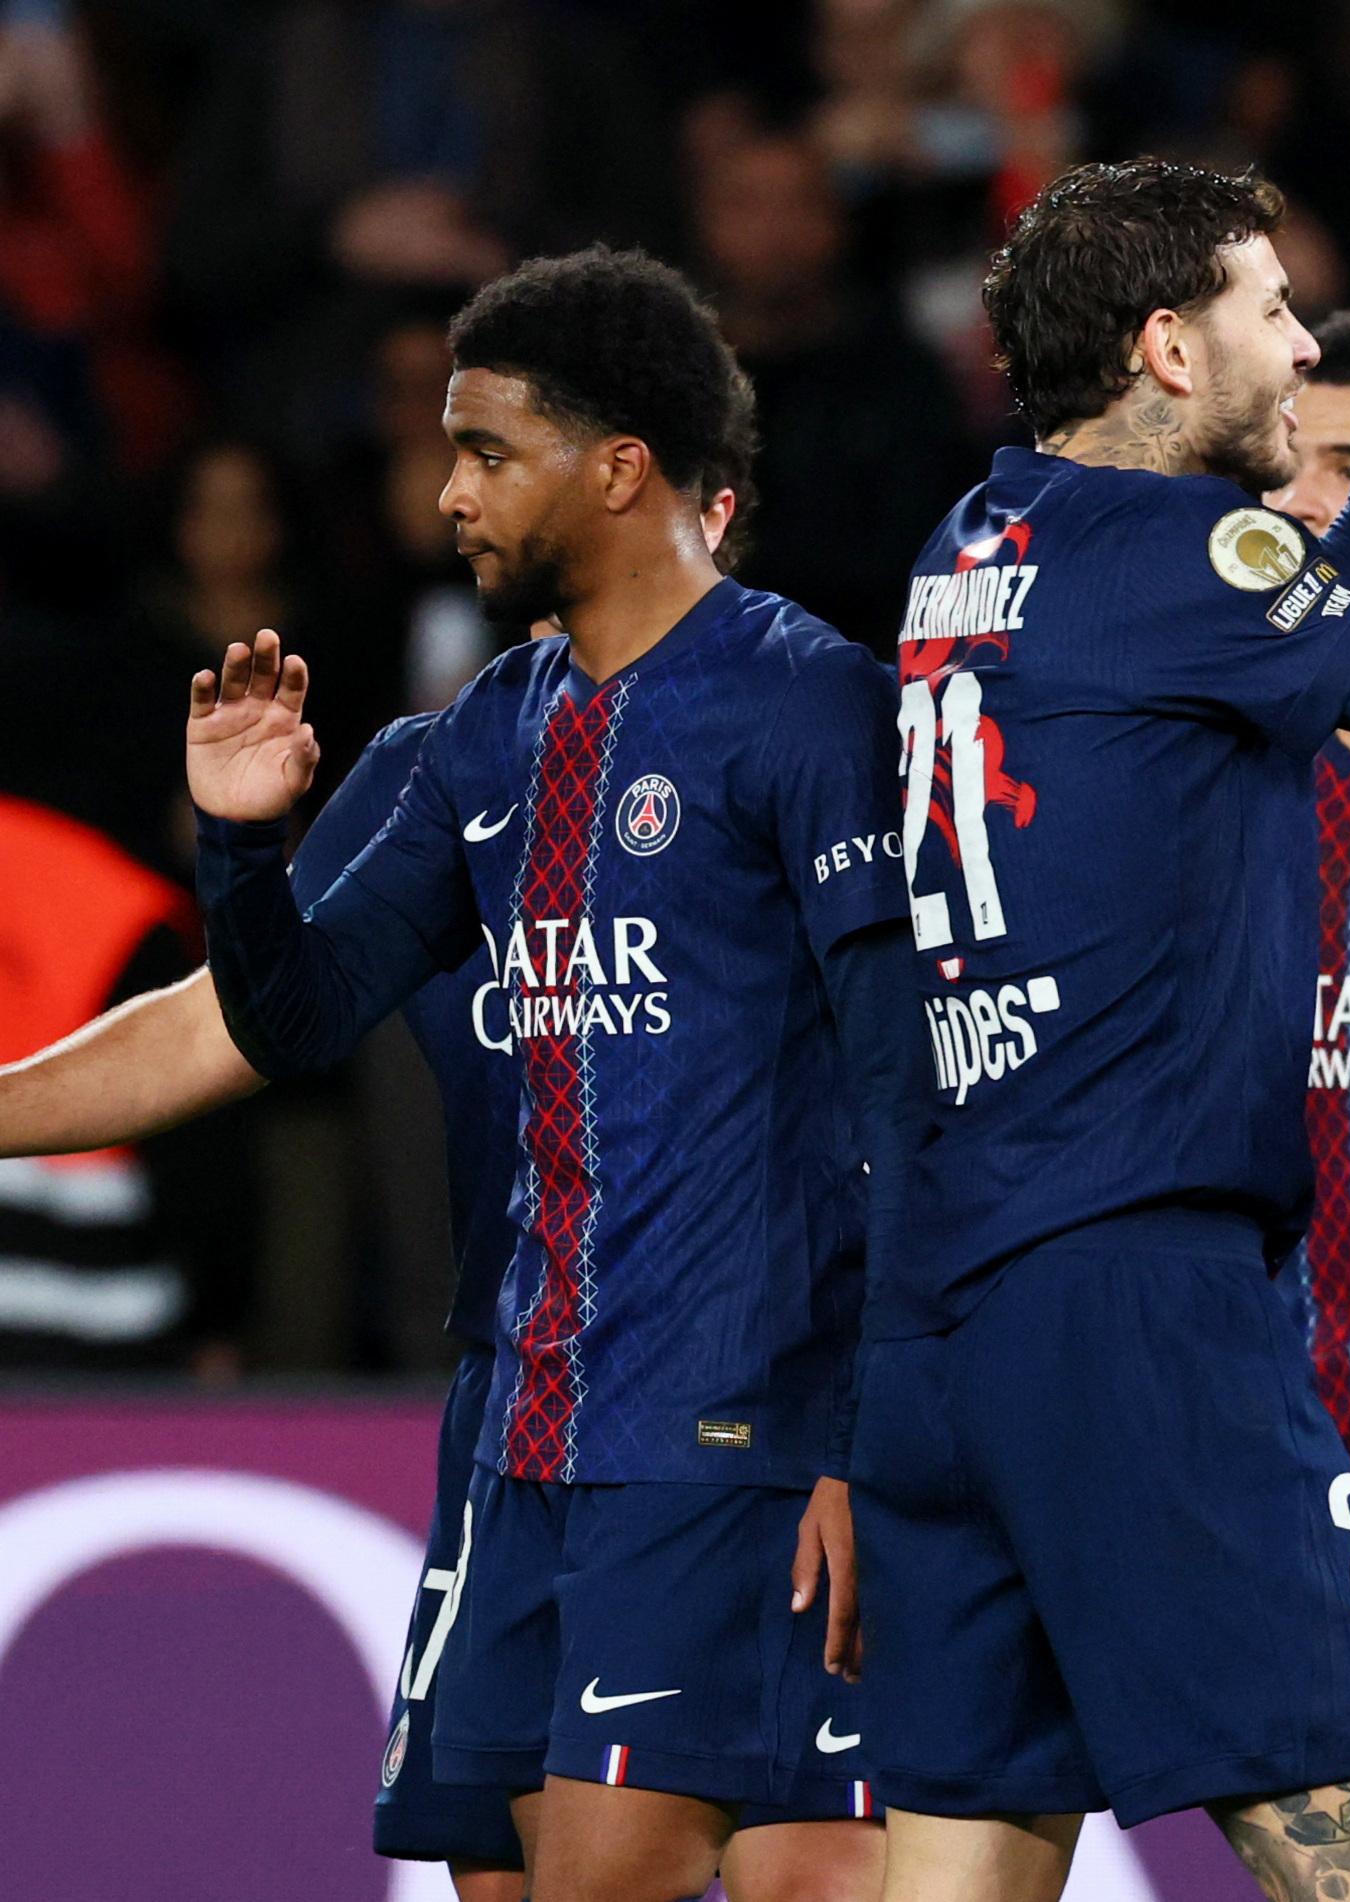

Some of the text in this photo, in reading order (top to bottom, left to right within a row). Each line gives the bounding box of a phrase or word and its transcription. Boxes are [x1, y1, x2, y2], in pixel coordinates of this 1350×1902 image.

[631, 778, 672, 798] PARIS
[897, 671, 1007, 951] 21
[813, 831, 904, 884] BEYO
[481, 917, 668, 989] ATAR
[509, 991, 672, 1039] AIRWAYS
